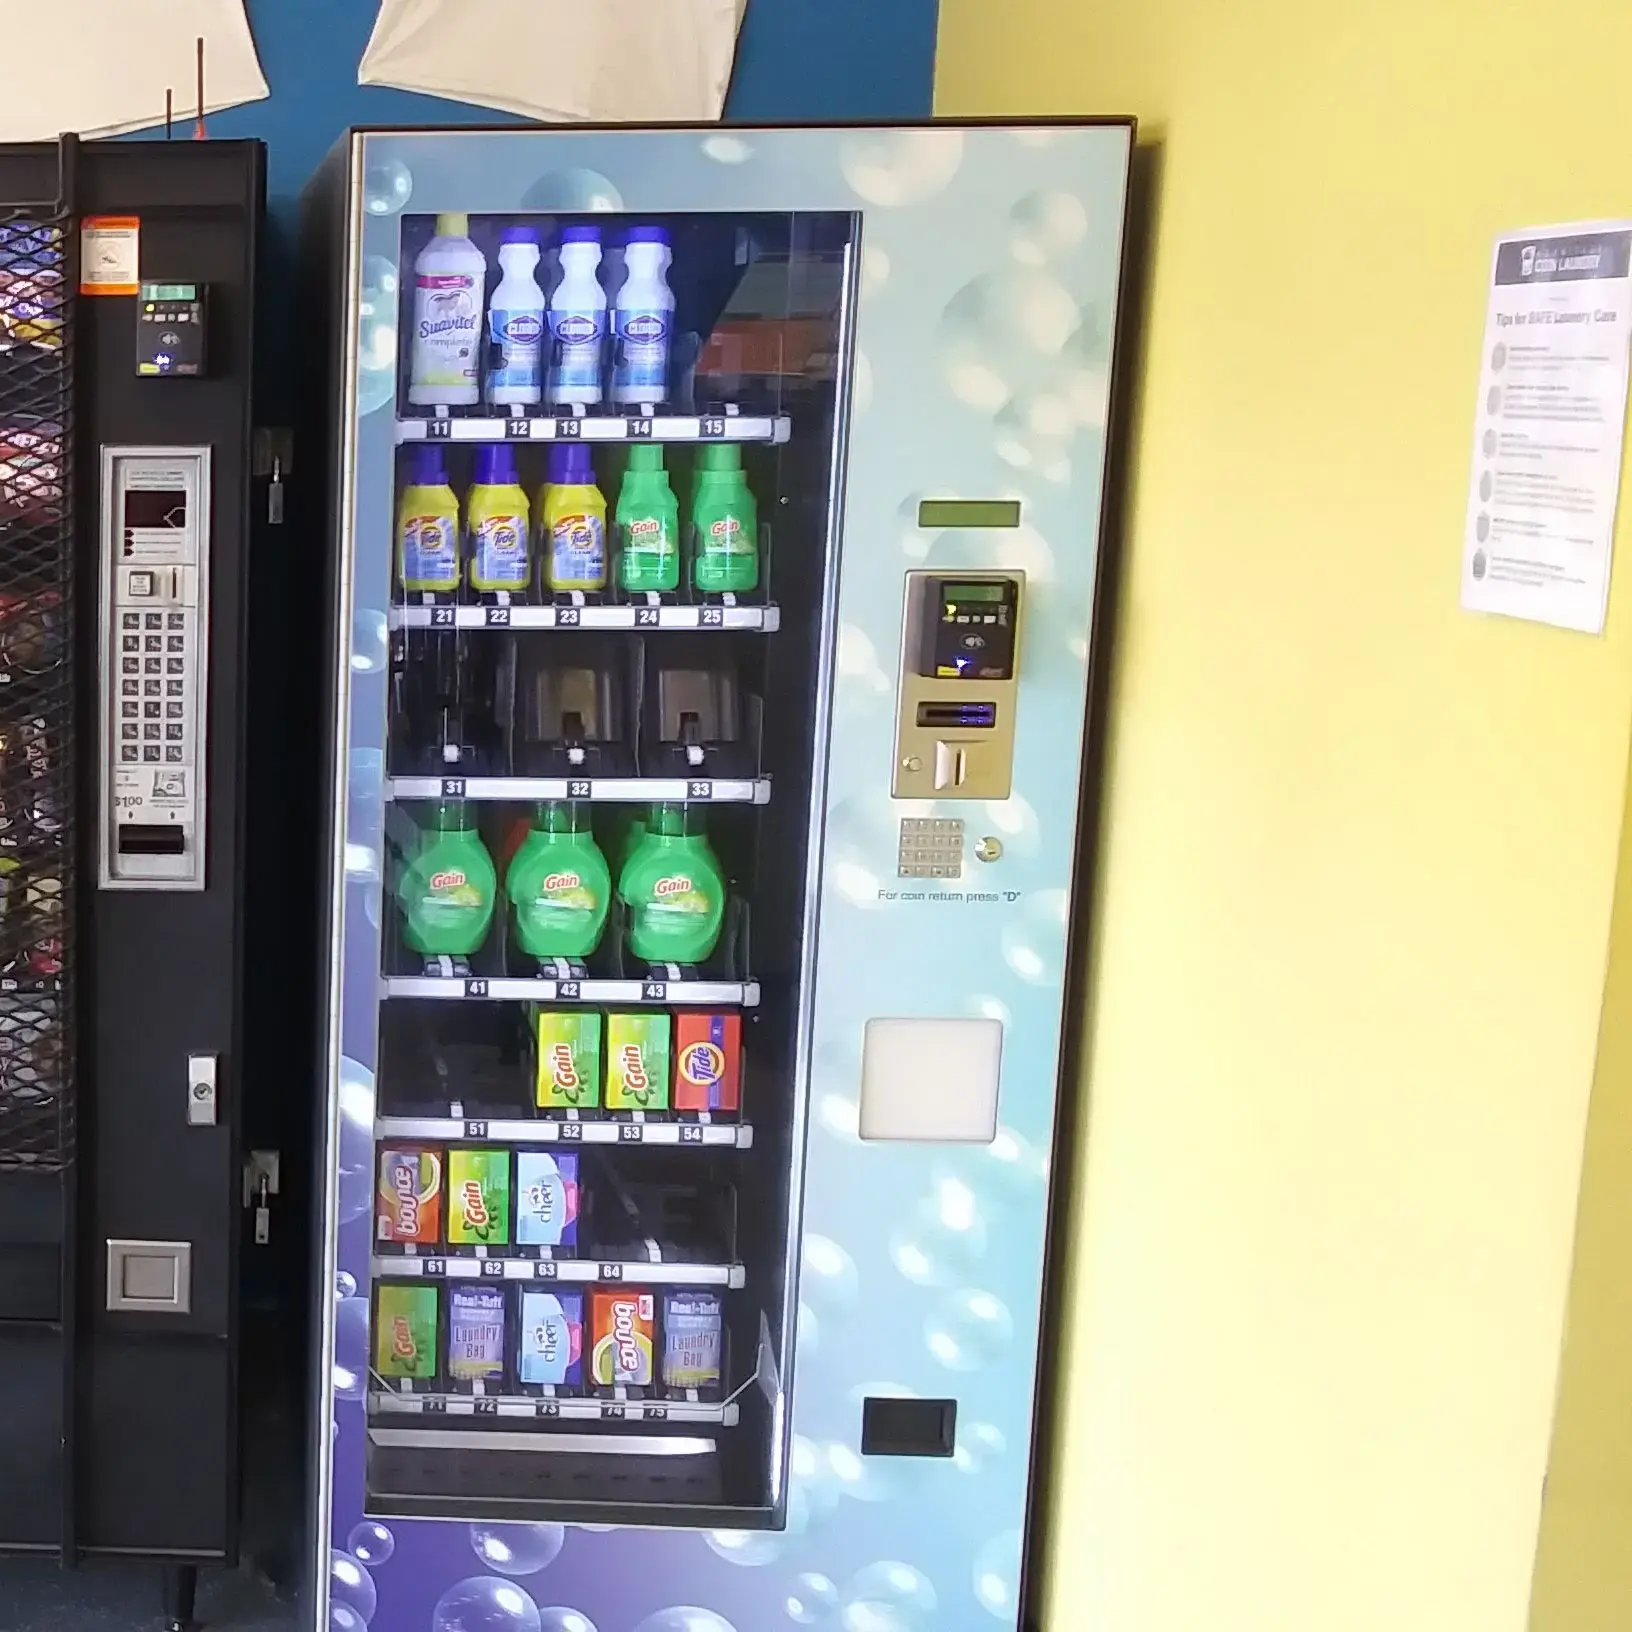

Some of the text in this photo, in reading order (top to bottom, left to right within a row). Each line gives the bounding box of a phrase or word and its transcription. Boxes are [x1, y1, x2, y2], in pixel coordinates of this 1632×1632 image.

[420, 314, 477, 338] Suavitel
[432, 420, 722, 435] 11 12 13 14 15
[631, 520, 658, 534] Gain
[712, 520, 739, 534] Gain
[435, 610, 721, 623] 21 22 23 24 25
[446, 781, 709, 796] 31 32 33
[431, 872, 464, 888] Gain
[545, 874, 578, 890] Gain
[656, 878, 690, 894] Gain
[878, 889, 898, 900] For
[900, 891, 925, 901] coin
[928, 891, 963, 901] return
[966, 892, 999, 903] press
[470, 982, 663, 997] 41 42 43
[553, 1045, 576, 1087] Gain
[623, 1046, 647, 1089] Gain
[691, 1047, 716, 1080] Tide
[469, 1124, 700, 1140] 51 52 53 54
[395, 1166, 418, 1236] bounce
[464, 1181, 486, 1224] Gain
[428, 1261, 620, 1278] 61 62 63 64
[455, 1325, 499, 1342] Laundry
[614, 1302, 639, 1371] bounce
[672, 1332, 715, 1352] Laundry
[466, 1343, 485, 1359] Bag
[683, 1351, 702, 1367] Bag
